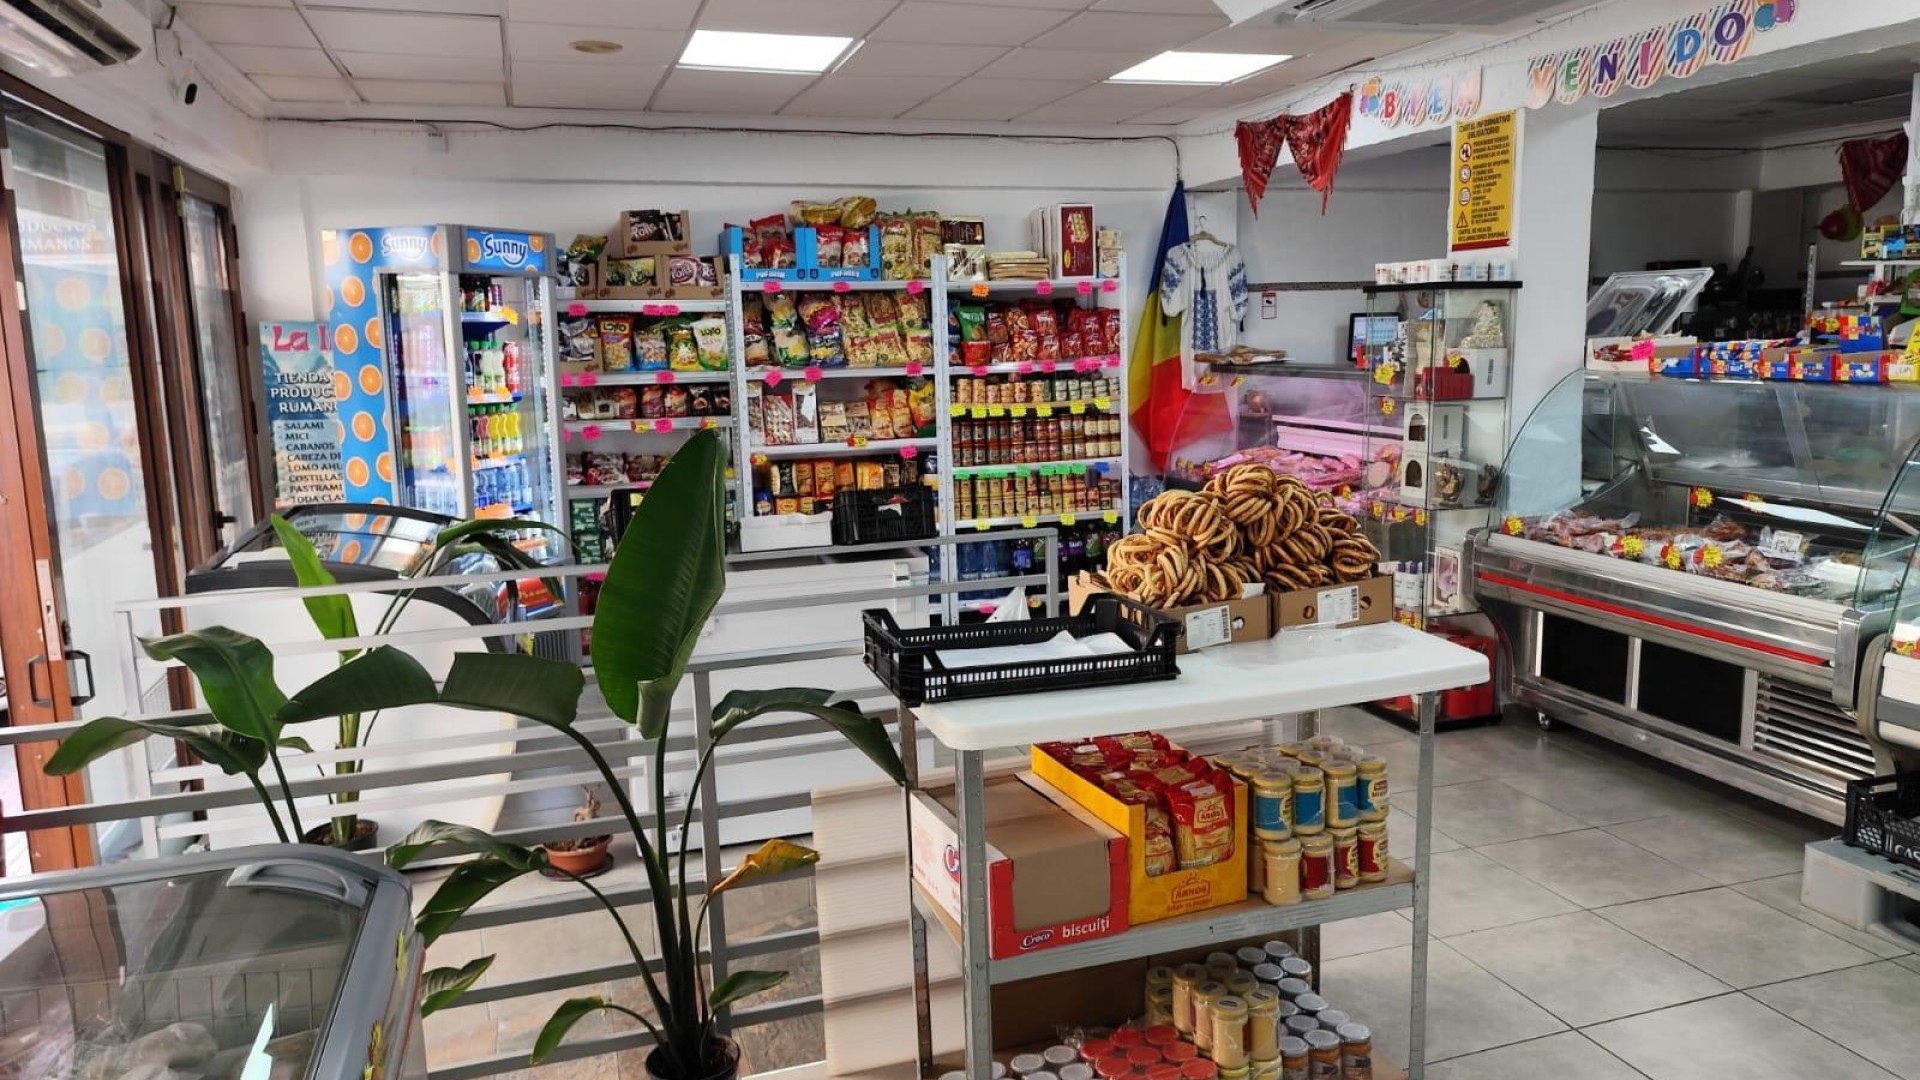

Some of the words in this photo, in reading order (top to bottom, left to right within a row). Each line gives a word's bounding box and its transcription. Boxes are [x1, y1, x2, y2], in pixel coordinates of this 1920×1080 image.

[1533, 12, 1747, 97] VENIDO
[485, 234, 527, 261] Sunny
[275, 372, 331, 385] TIENDA
[285, 422, 324, 430] SALAMI
[286, 433, 309, 441] MICI
[288, 453, 327, 462] CABEZA
[1022, 933, 1051, 948] Croco
